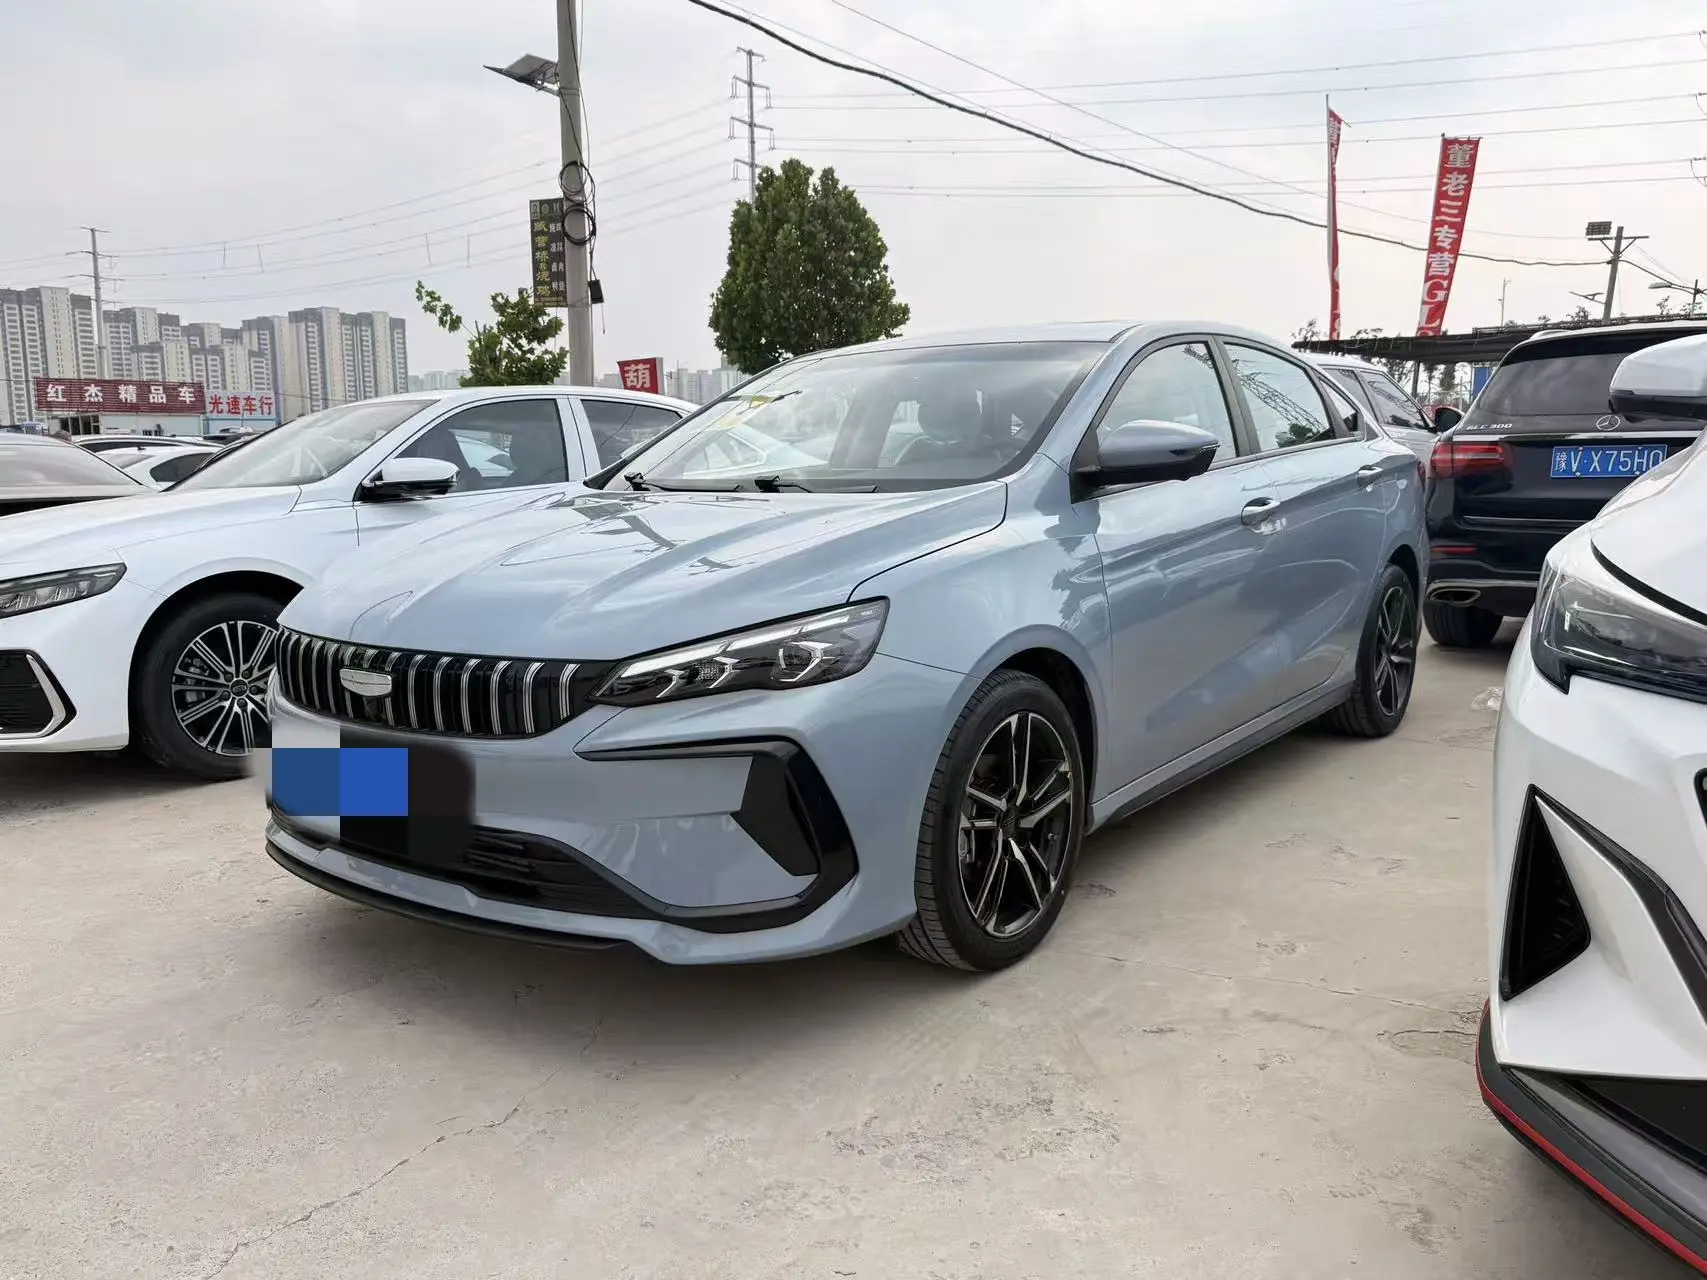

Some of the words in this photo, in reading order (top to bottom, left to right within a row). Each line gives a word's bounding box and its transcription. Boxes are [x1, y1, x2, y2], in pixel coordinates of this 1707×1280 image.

[623, 363, 651, 388] 葫
[47, 384, 196, 404] 红杰精品车
[209, 395, 273, 415] 光速车行
[1489, 422, 1512, 430] 300
